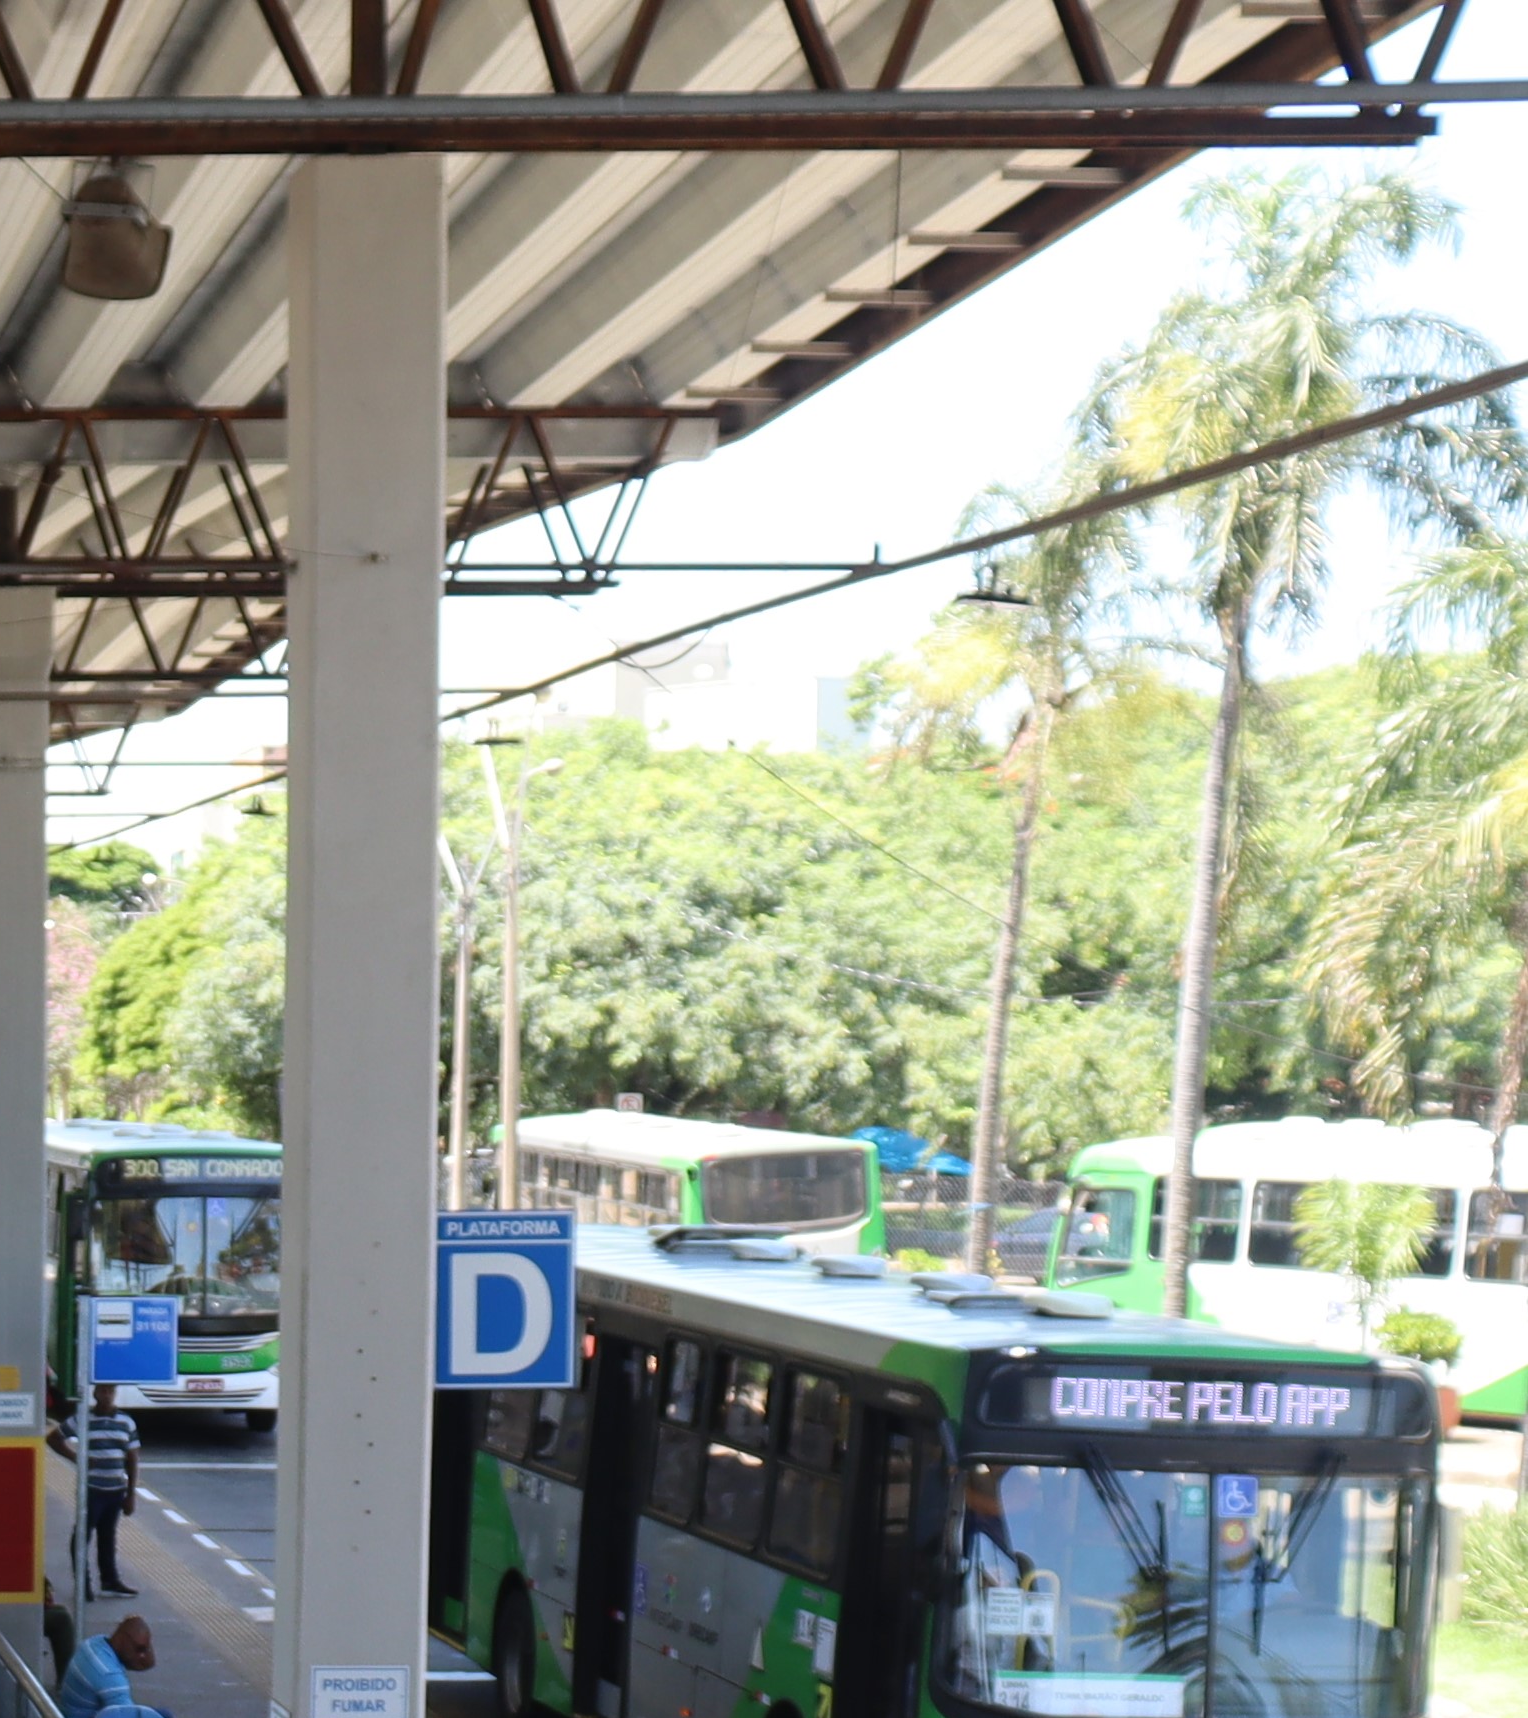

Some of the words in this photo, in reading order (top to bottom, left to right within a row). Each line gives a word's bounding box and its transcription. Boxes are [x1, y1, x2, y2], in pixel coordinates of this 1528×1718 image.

[163, 1160, 200, 1178] SAN
[447, 1220, 561, 1237] PLATAFORMA
[450, 1252, 553, 1376] D
[1054, 1376, 1185, 1420] COMPRE
[1191, 1381, 1279, 1424] PELO
[1285, 1384, 1351, 1426] APP
[323, 1678, 398, 1692] PROIBIDO
[332, 1701, 387, 1713] FUMAR
